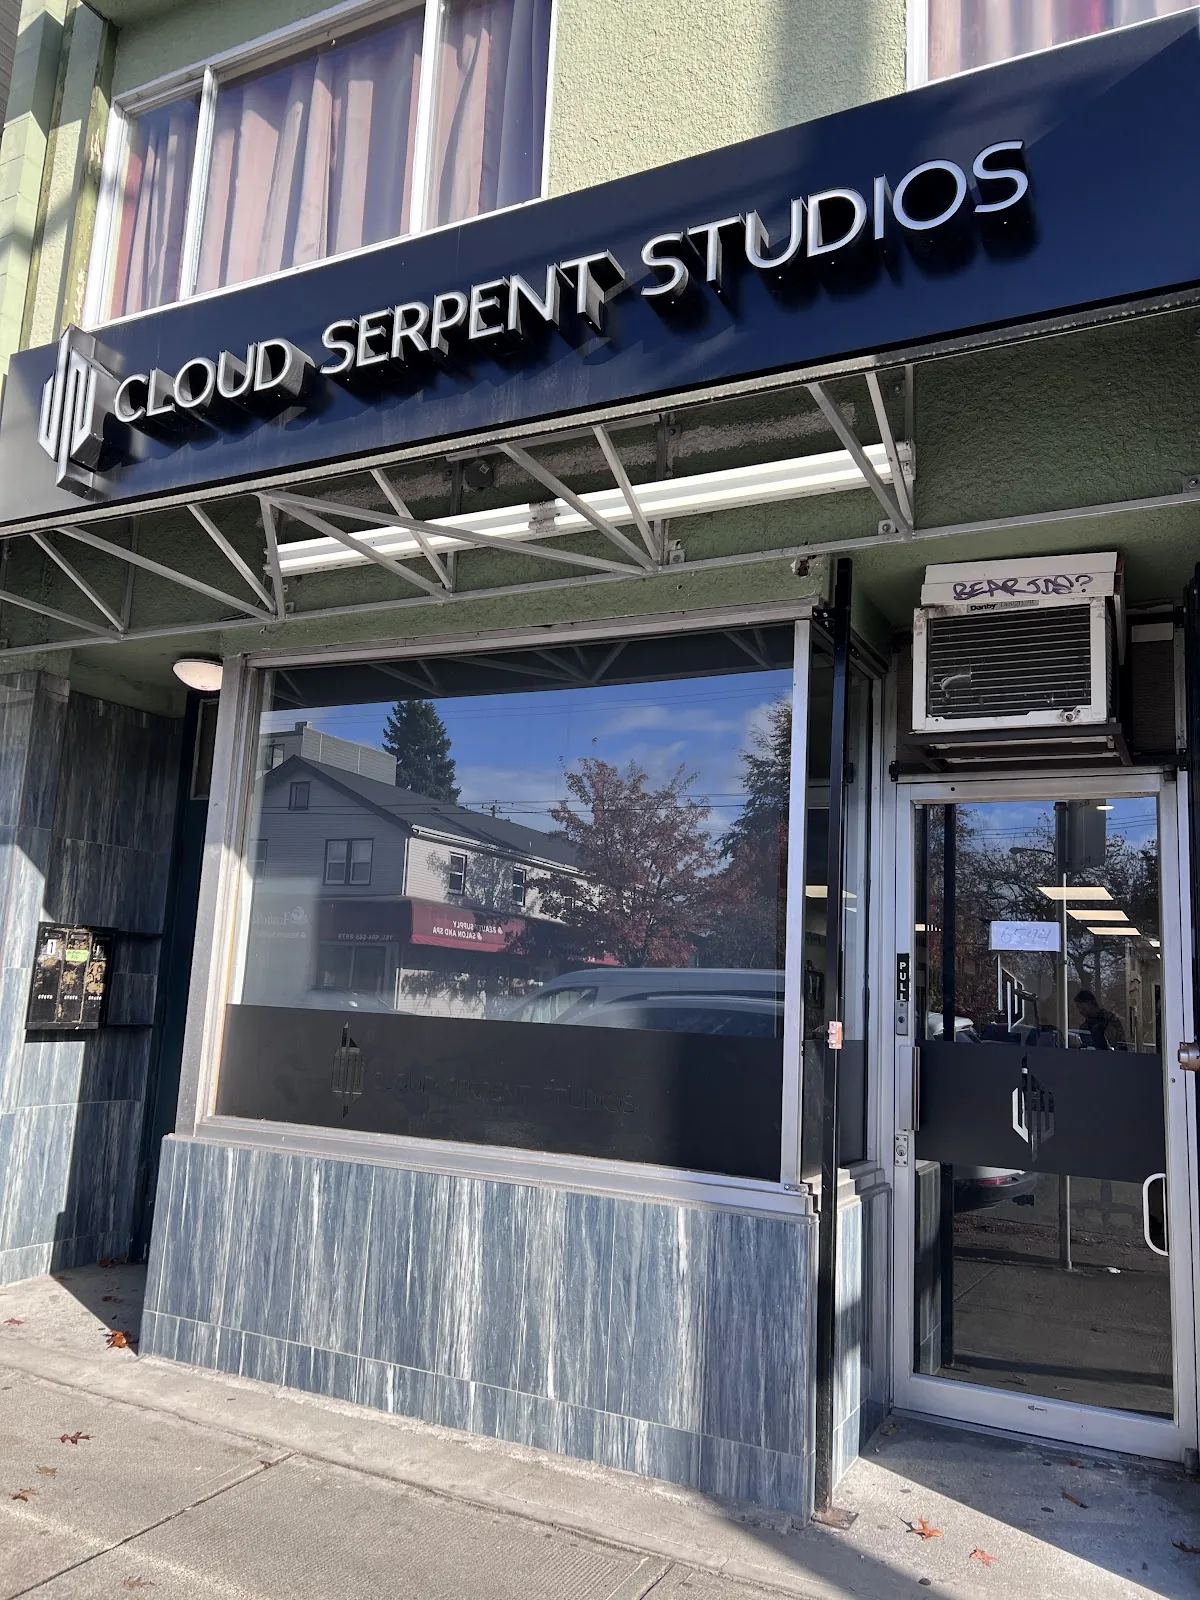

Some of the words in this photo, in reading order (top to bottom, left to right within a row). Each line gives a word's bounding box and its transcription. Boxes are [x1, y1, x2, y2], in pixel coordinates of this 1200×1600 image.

[113, 337, 295, 424] CLOUD
[321, 250, 610, 375] SERPENT
[640, 138, 1029, 297] STUDIOS
[953, 577, 1020, 600] BEAR
[970, 603, 998, 611] Danby
[1001, 926, 1052, 945] 6594
